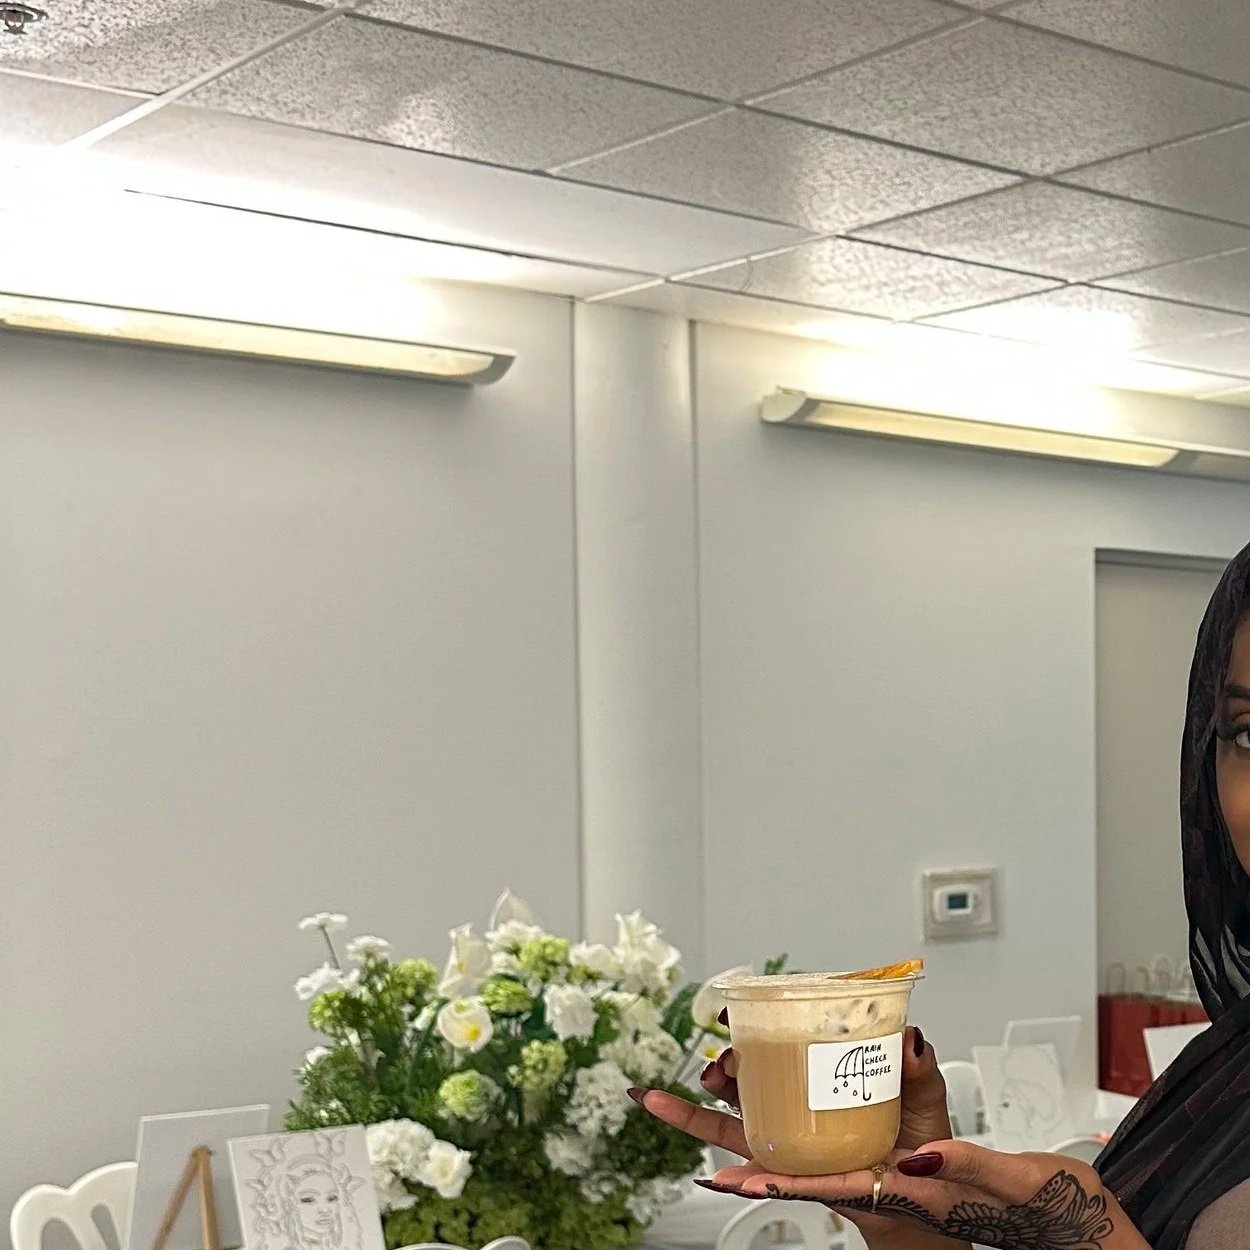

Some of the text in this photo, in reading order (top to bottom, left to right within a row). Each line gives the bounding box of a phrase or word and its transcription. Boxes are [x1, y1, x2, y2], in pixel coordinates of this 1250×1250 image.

[864, 1043, 881, 1053] RAIN
[865, 1054, 887, 1065] CHECK
[865, 1065, 891, 1077] COFFEE
